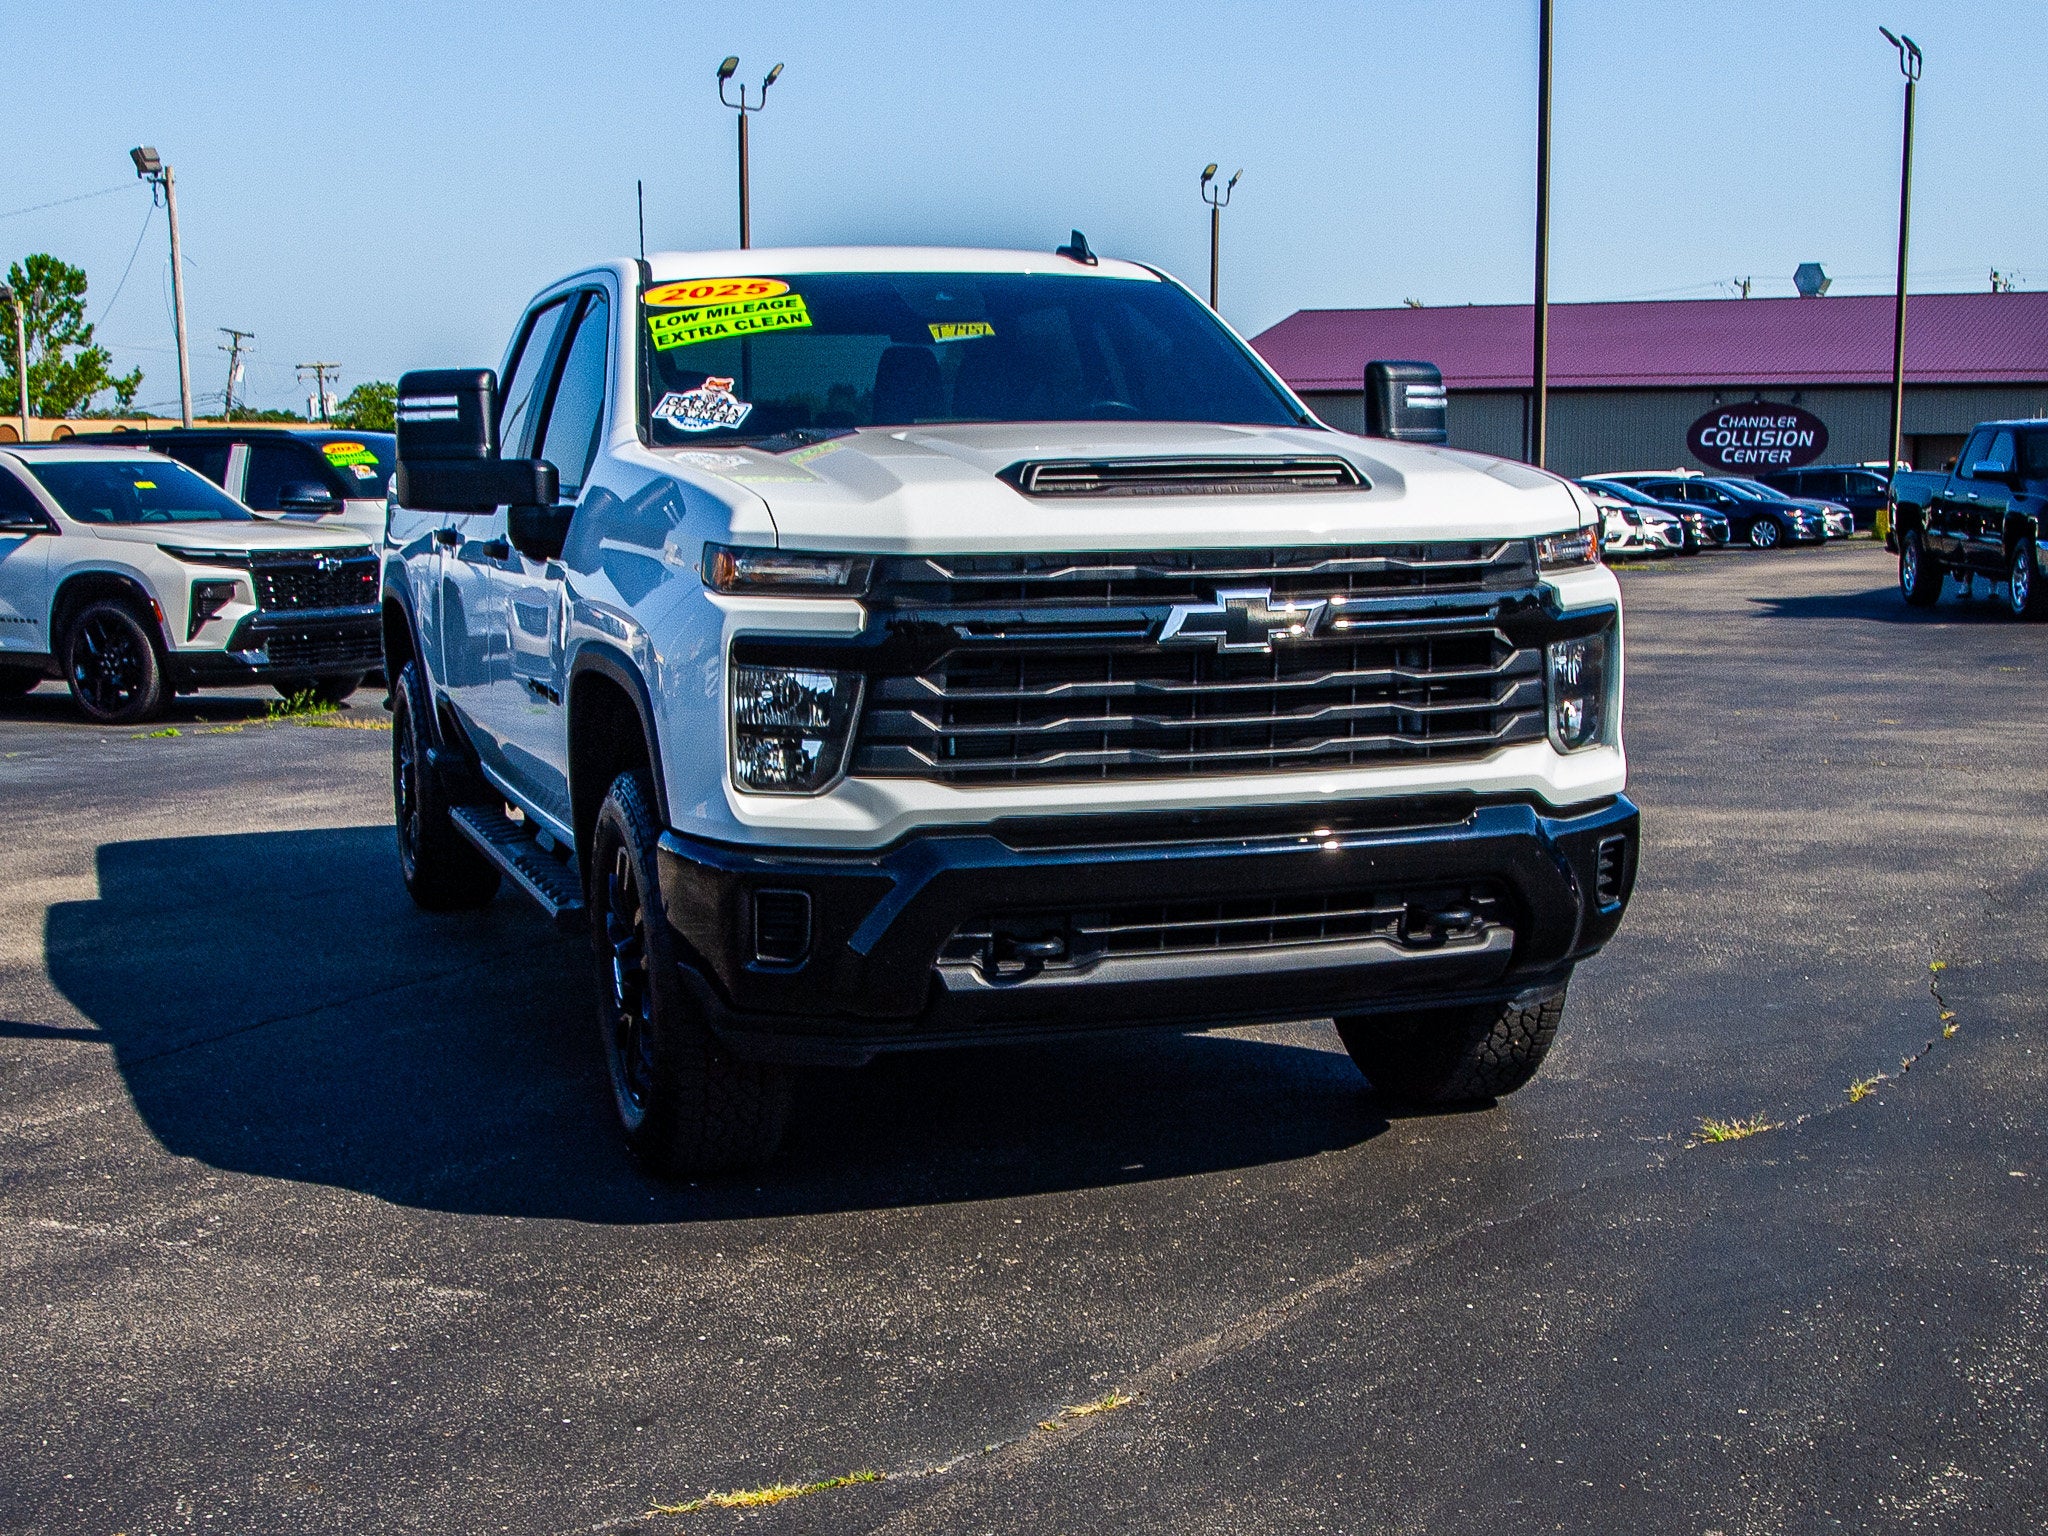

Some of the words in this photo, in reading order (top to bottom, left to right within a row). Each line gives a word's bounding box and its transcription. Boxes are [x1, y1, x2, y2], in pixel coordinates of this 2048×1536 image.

[658, 282, 770, 303] 2025
[655, 311, 699, 330] LOW
[706, 299, 797, 319] MILEAGE
[656, 324, 728, 346] EXTRA
[734, 313, 803, 331] CLEAN
[1718, 414, 1797, 428] CHANDLER
[1700, 428, 1815, 447] COLLISION
[1721, 447, 1792, 463] CENTER
